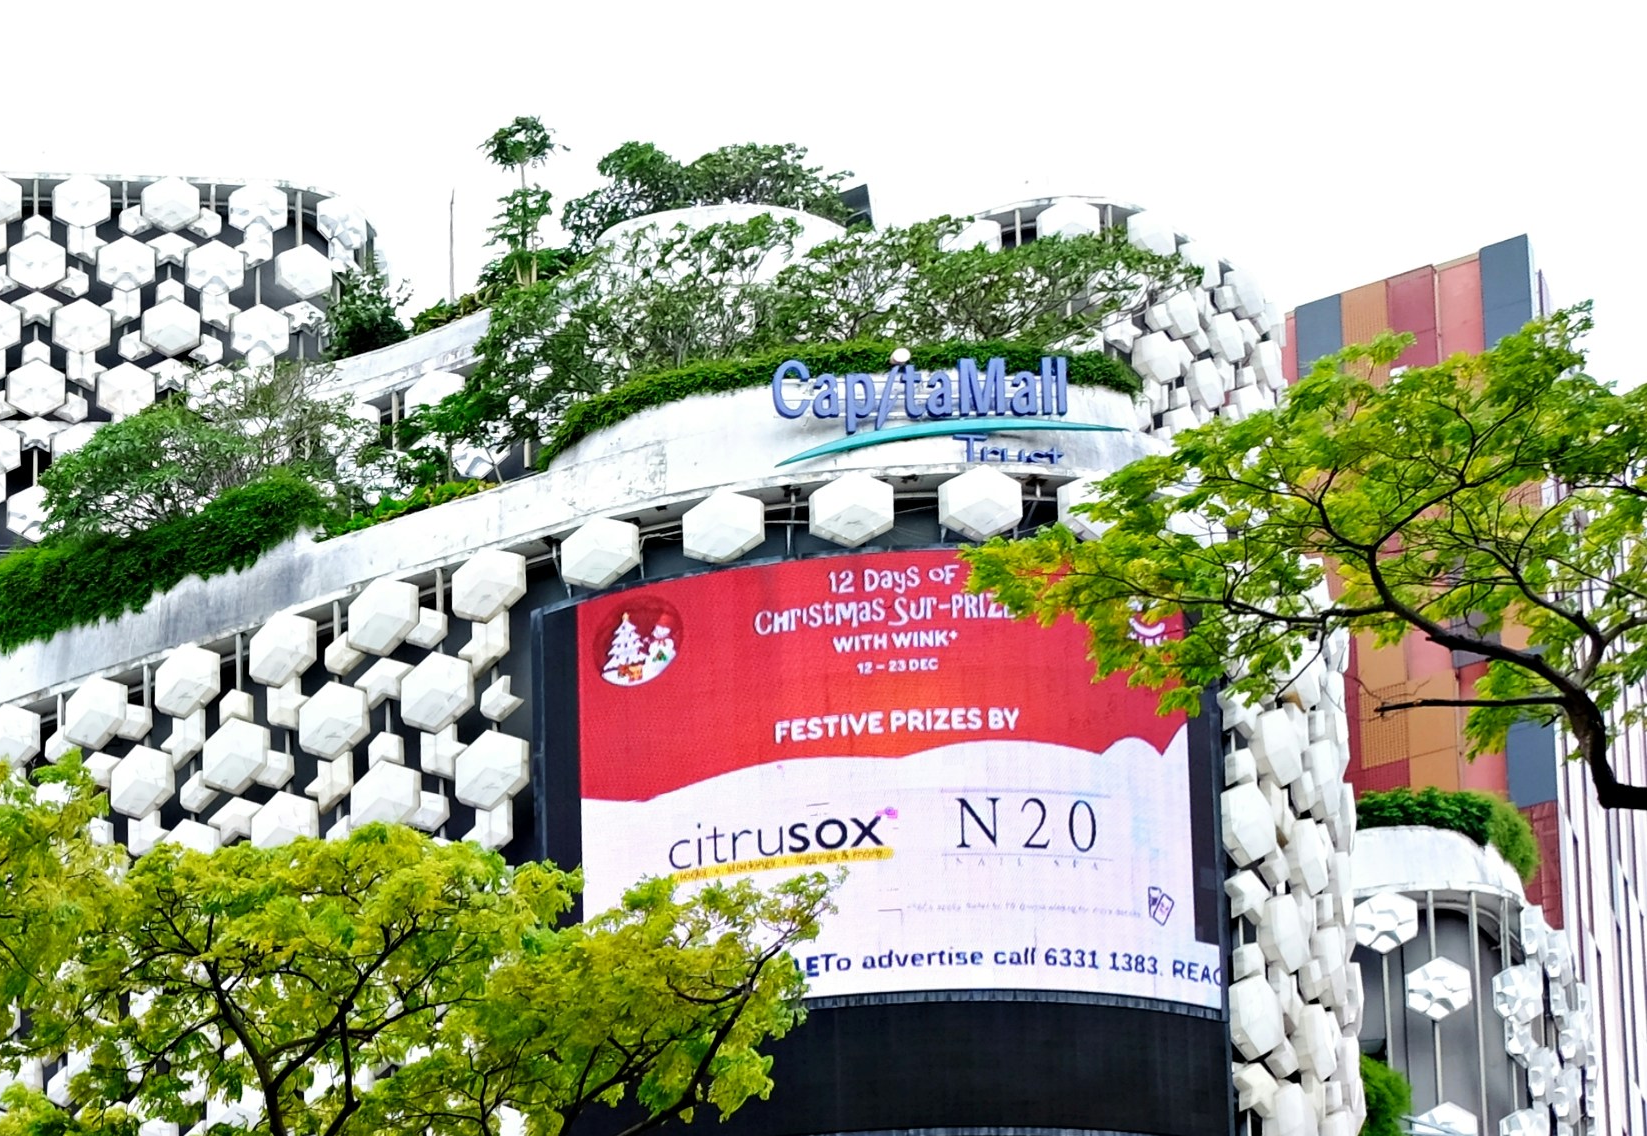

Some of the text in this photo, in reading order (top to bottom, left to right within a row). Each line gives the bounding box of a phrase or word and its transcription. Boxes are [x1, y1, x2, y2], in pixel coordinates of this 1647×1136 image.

[773, 349, 1068, 433] CapitaMall
[829, 570, 855, 593] 12
[833, 634, 887, 653] WITH
[857, 662, 872, 674] 12
[888, 660, 906, 673] 23
[909, 658, 938, 671] DEC
[775, 707, 1019, 744] FESTIVE PRIZES BY
[669, 816, 883, 869] citrusox
[862, 951, 983, 970] advertise
[994, 948, 1035, 966] call
[1044, 949, 1099, 969] 6331
